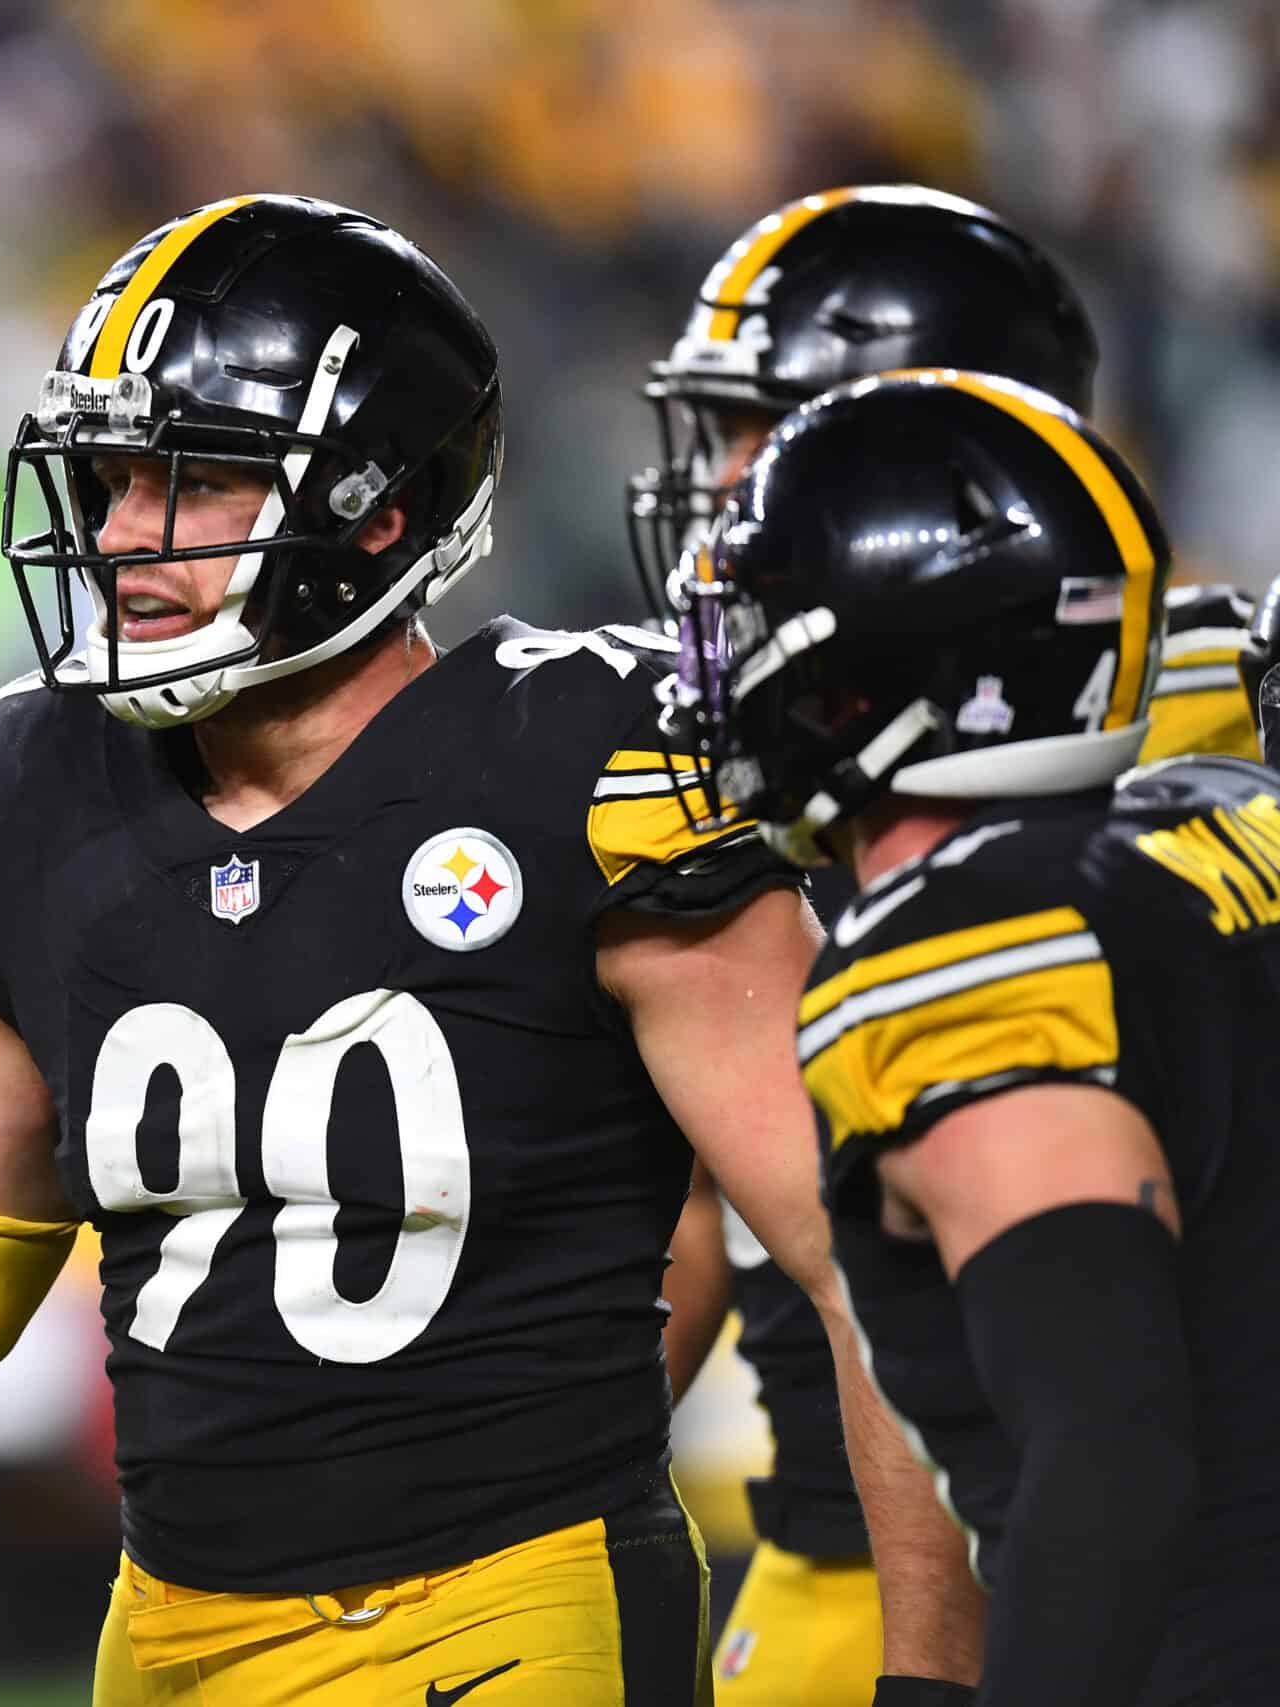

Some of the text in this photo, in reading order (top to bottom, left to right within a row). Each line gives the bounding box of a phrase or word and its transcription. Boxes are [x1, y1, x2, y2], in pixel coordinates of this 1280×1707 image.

[70, 384, 112, 412] Steeler
[218, 884, 252, 911] NFL
[413, 882, 459, 897] Steelers
[86, 988, 472, 1364] 90
